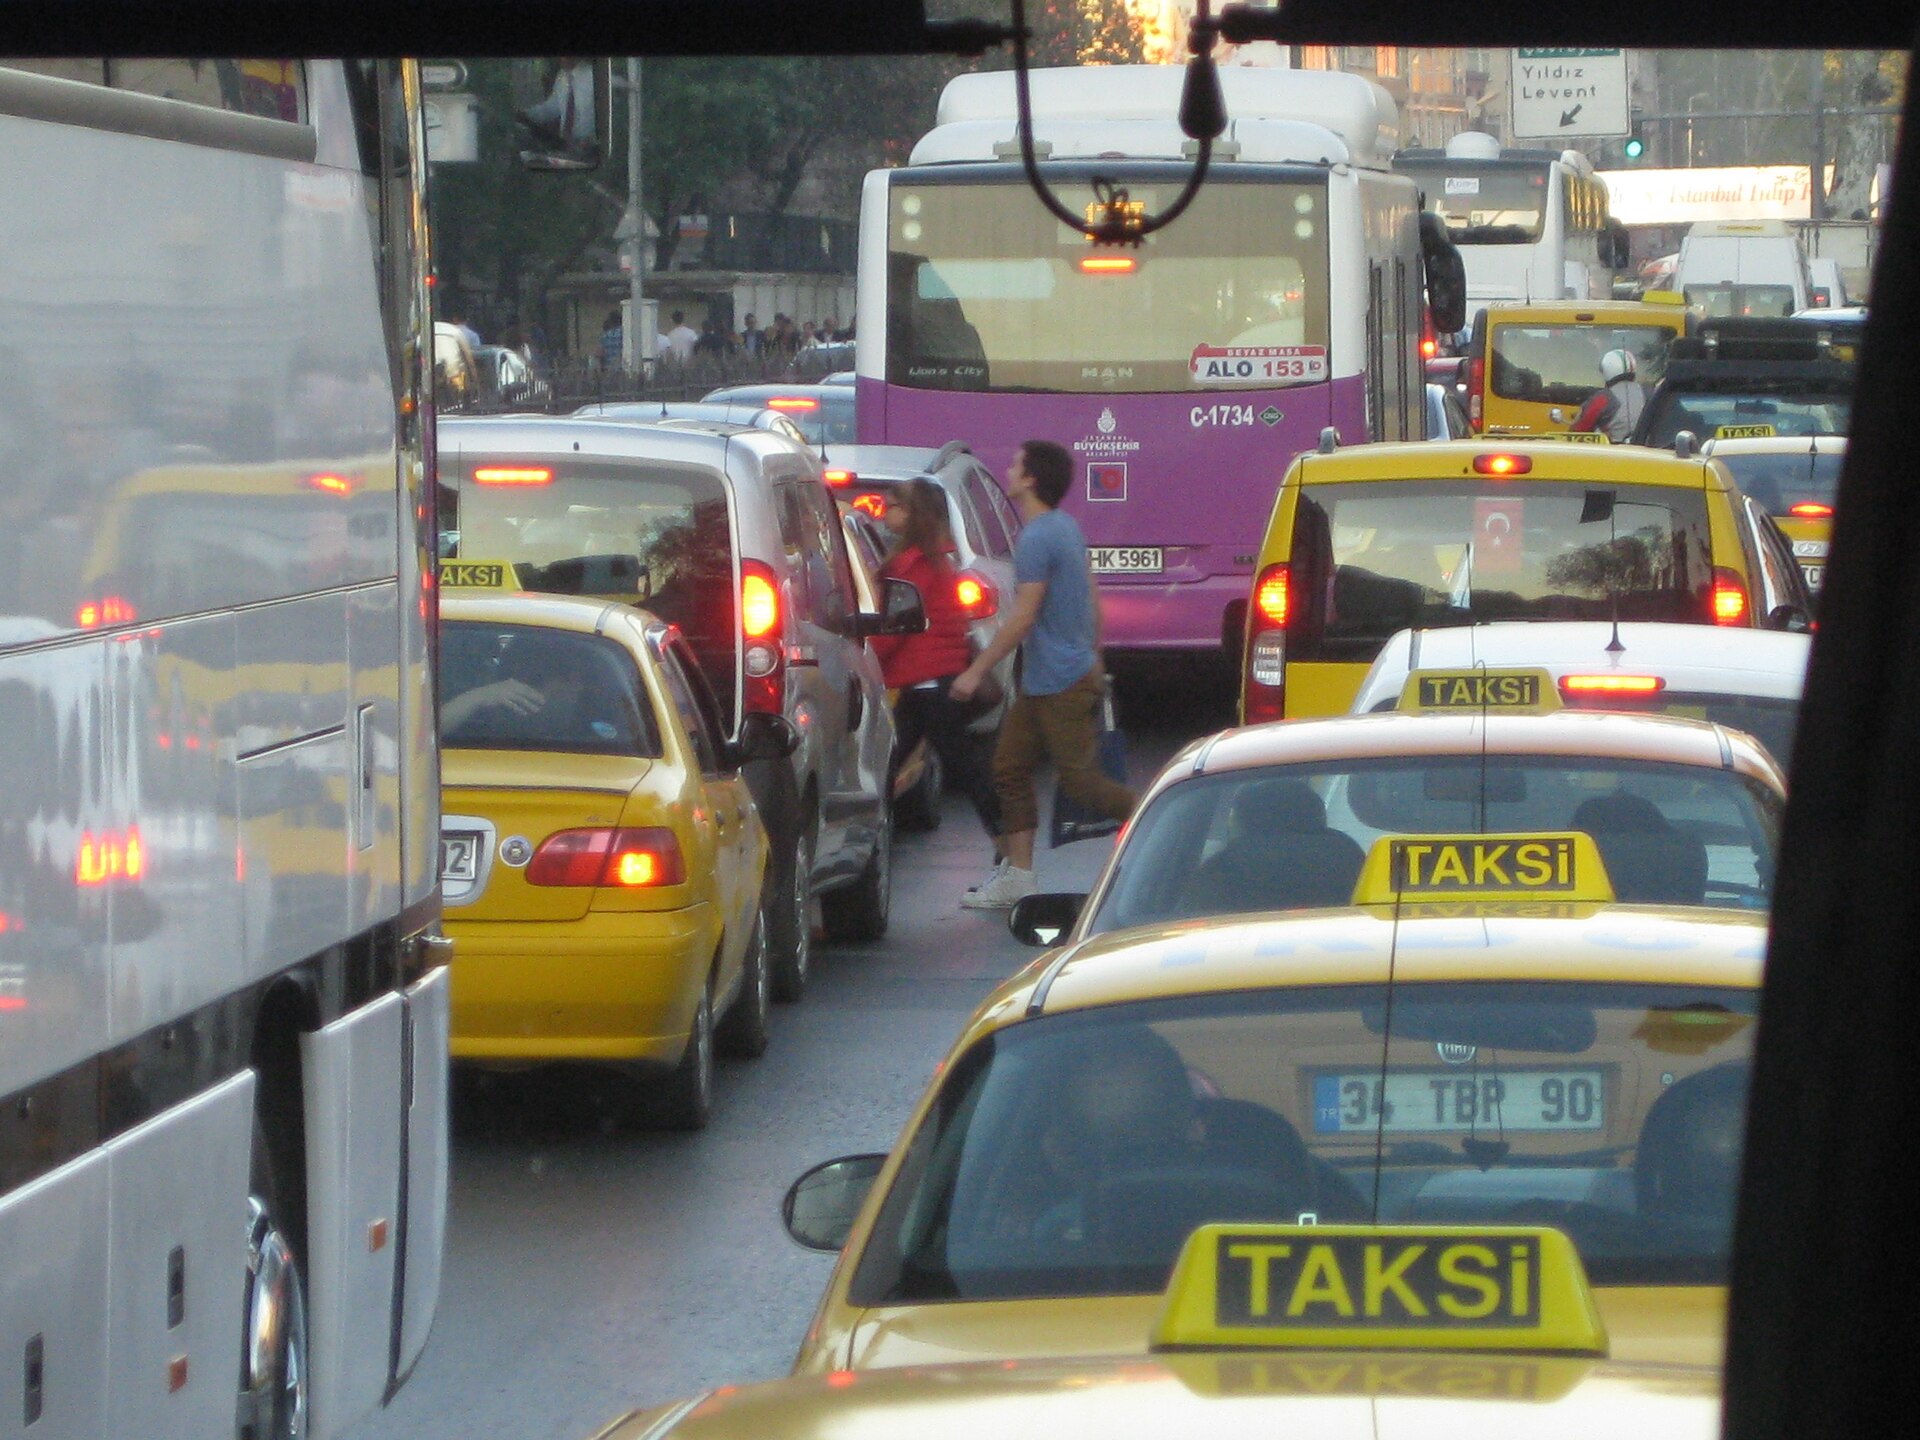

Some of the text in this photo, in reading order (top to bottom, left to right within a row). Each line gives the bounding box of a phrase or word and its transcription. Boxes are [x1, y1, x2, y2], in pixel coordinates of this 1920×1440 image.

[1523, 85, 1596, 99] Levent
[1206, 360, 1305, 377] ALO 153
[1190, 404, 1255, 428] C-1734
[1118, 550, 1159, 568] 5961
[1430, 1078, 1506, 1124] TBP
[1541, 1077, 1594, 1123] 90
